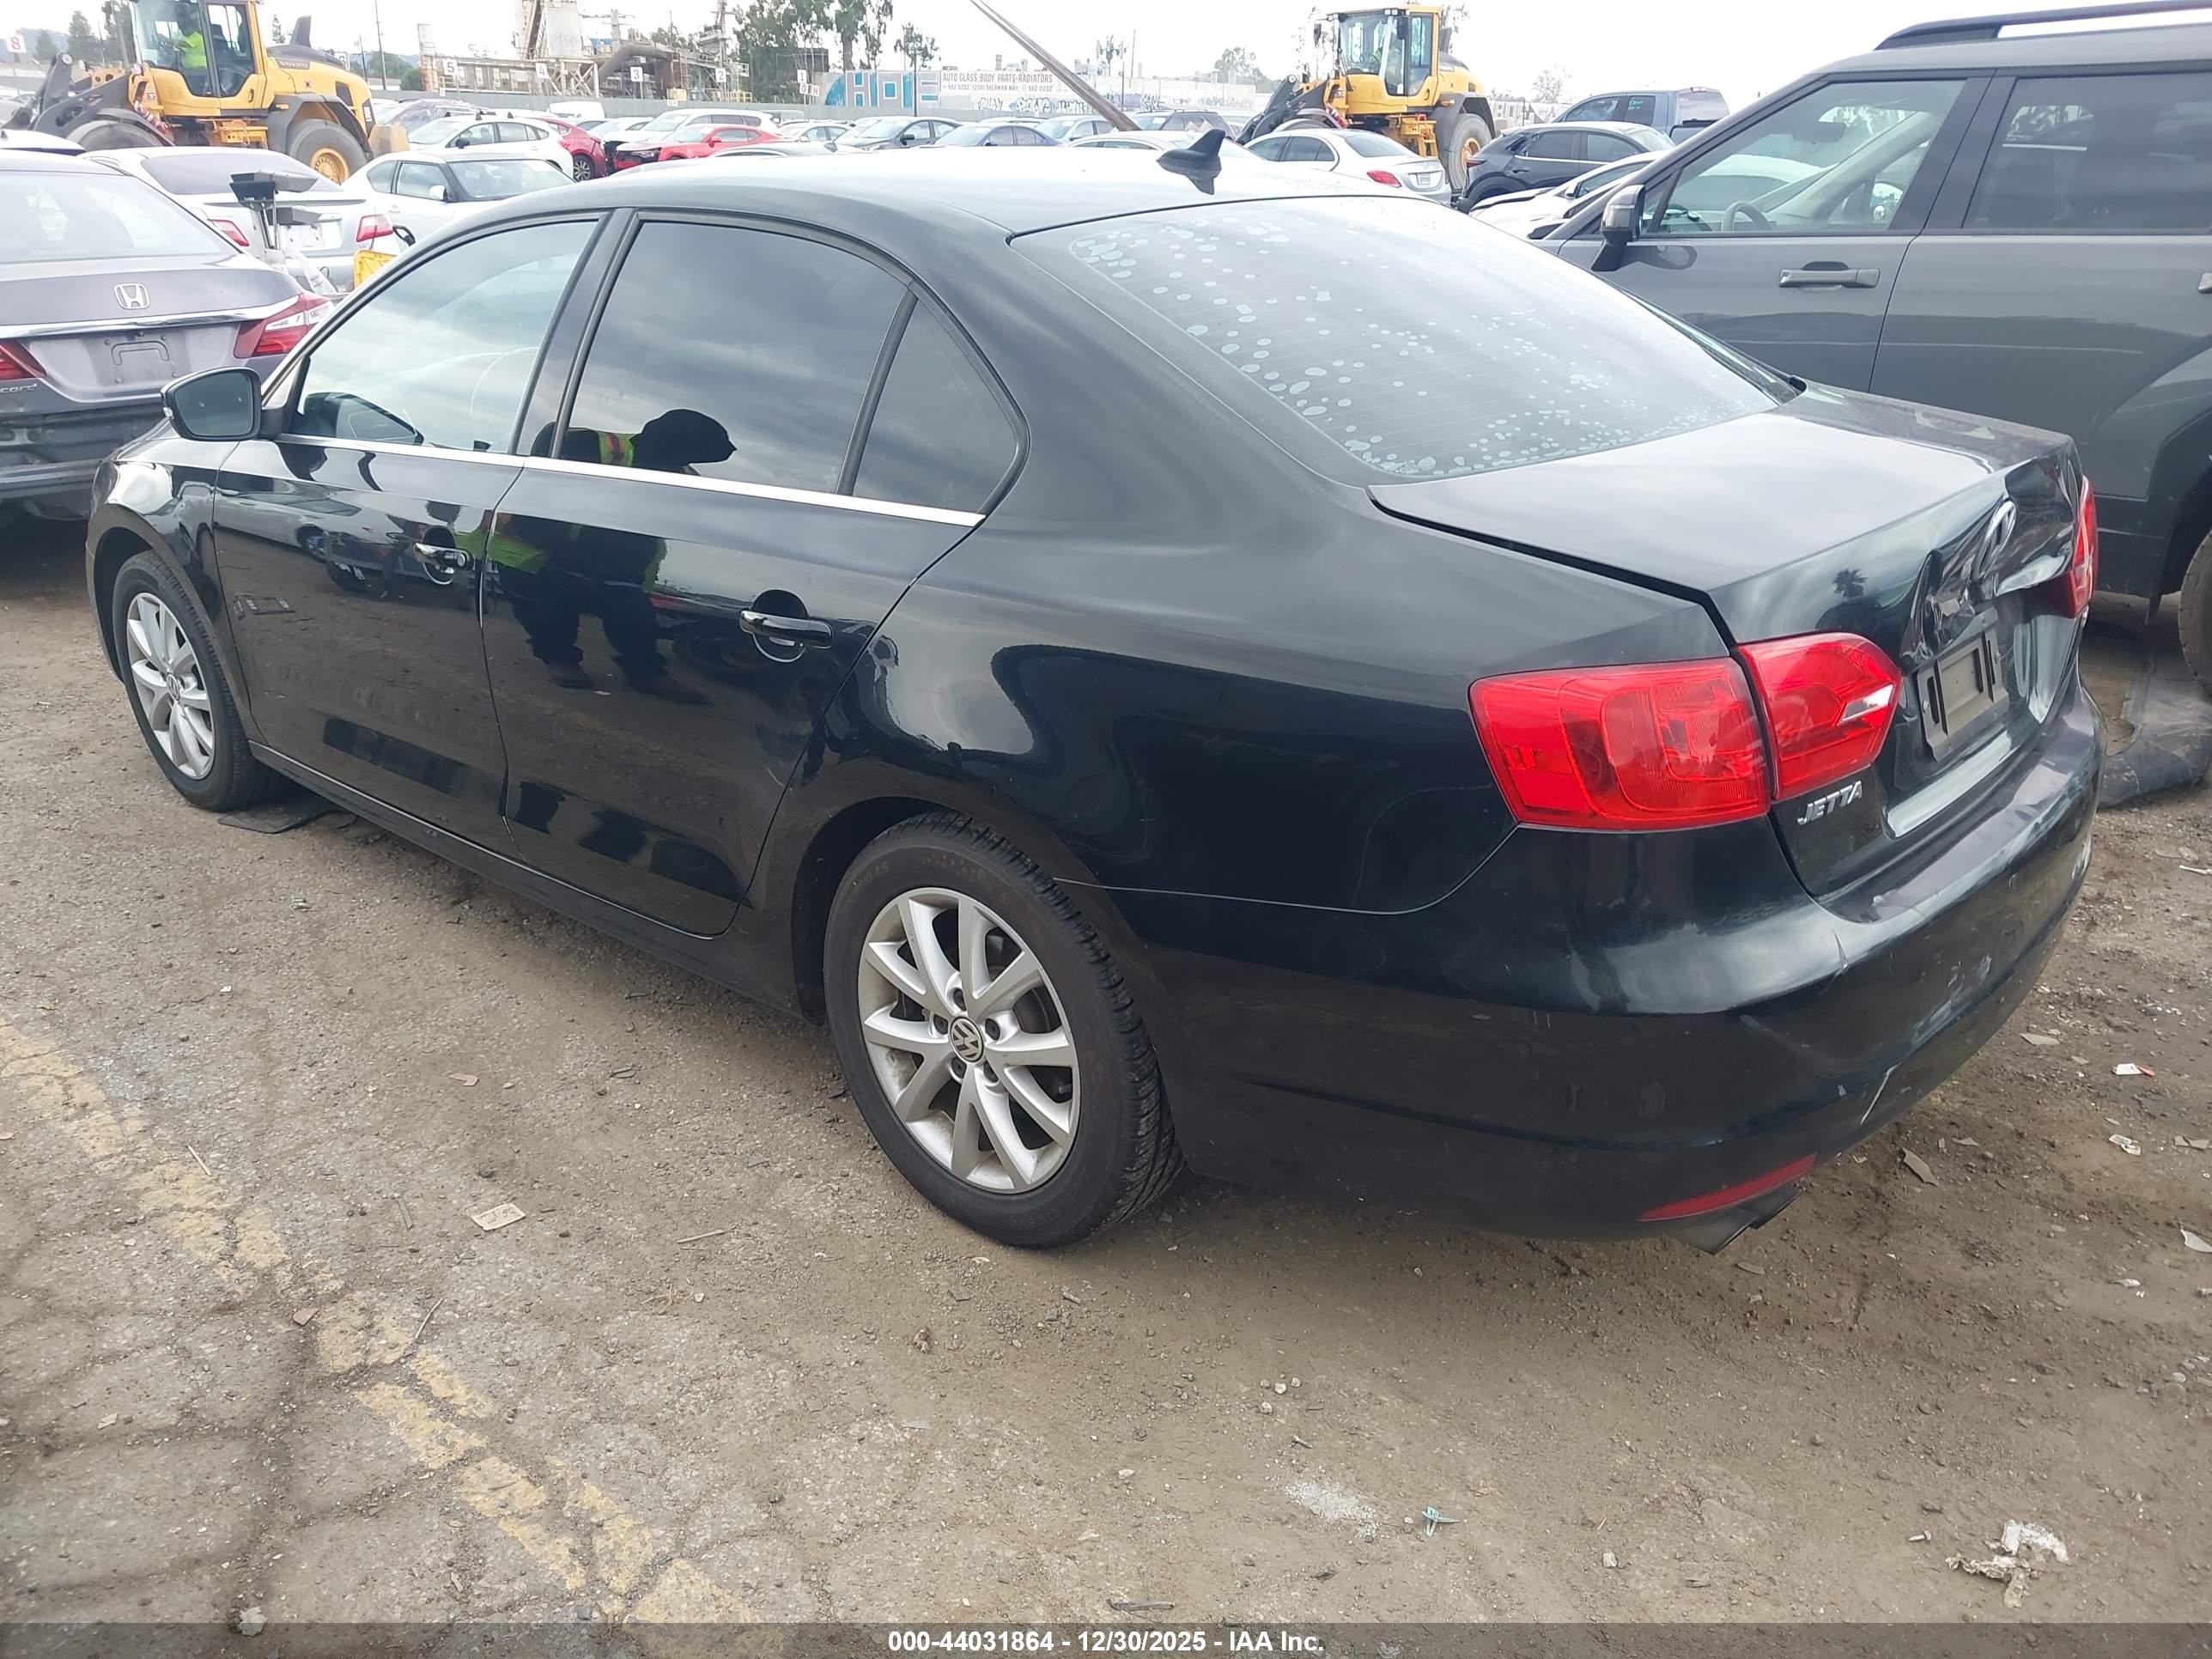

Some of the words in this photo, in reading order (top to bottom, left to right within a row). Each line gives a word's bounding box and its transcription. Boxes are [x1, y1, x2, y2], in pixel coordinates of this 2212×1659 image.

[10, 36, 21, 50] 8
[447, 63, 454, 73] 5
[538, 64, 545, 76] 4
[633, 68, 640, 79] 3
[718, 70, 725, 81] 2
[943, 72, 957, 82] AUTO
[959, 72, 977, 82] GLASS
[979, 73, 995, 82] BODY
[1796, 780, 1863, 825] JETTA
